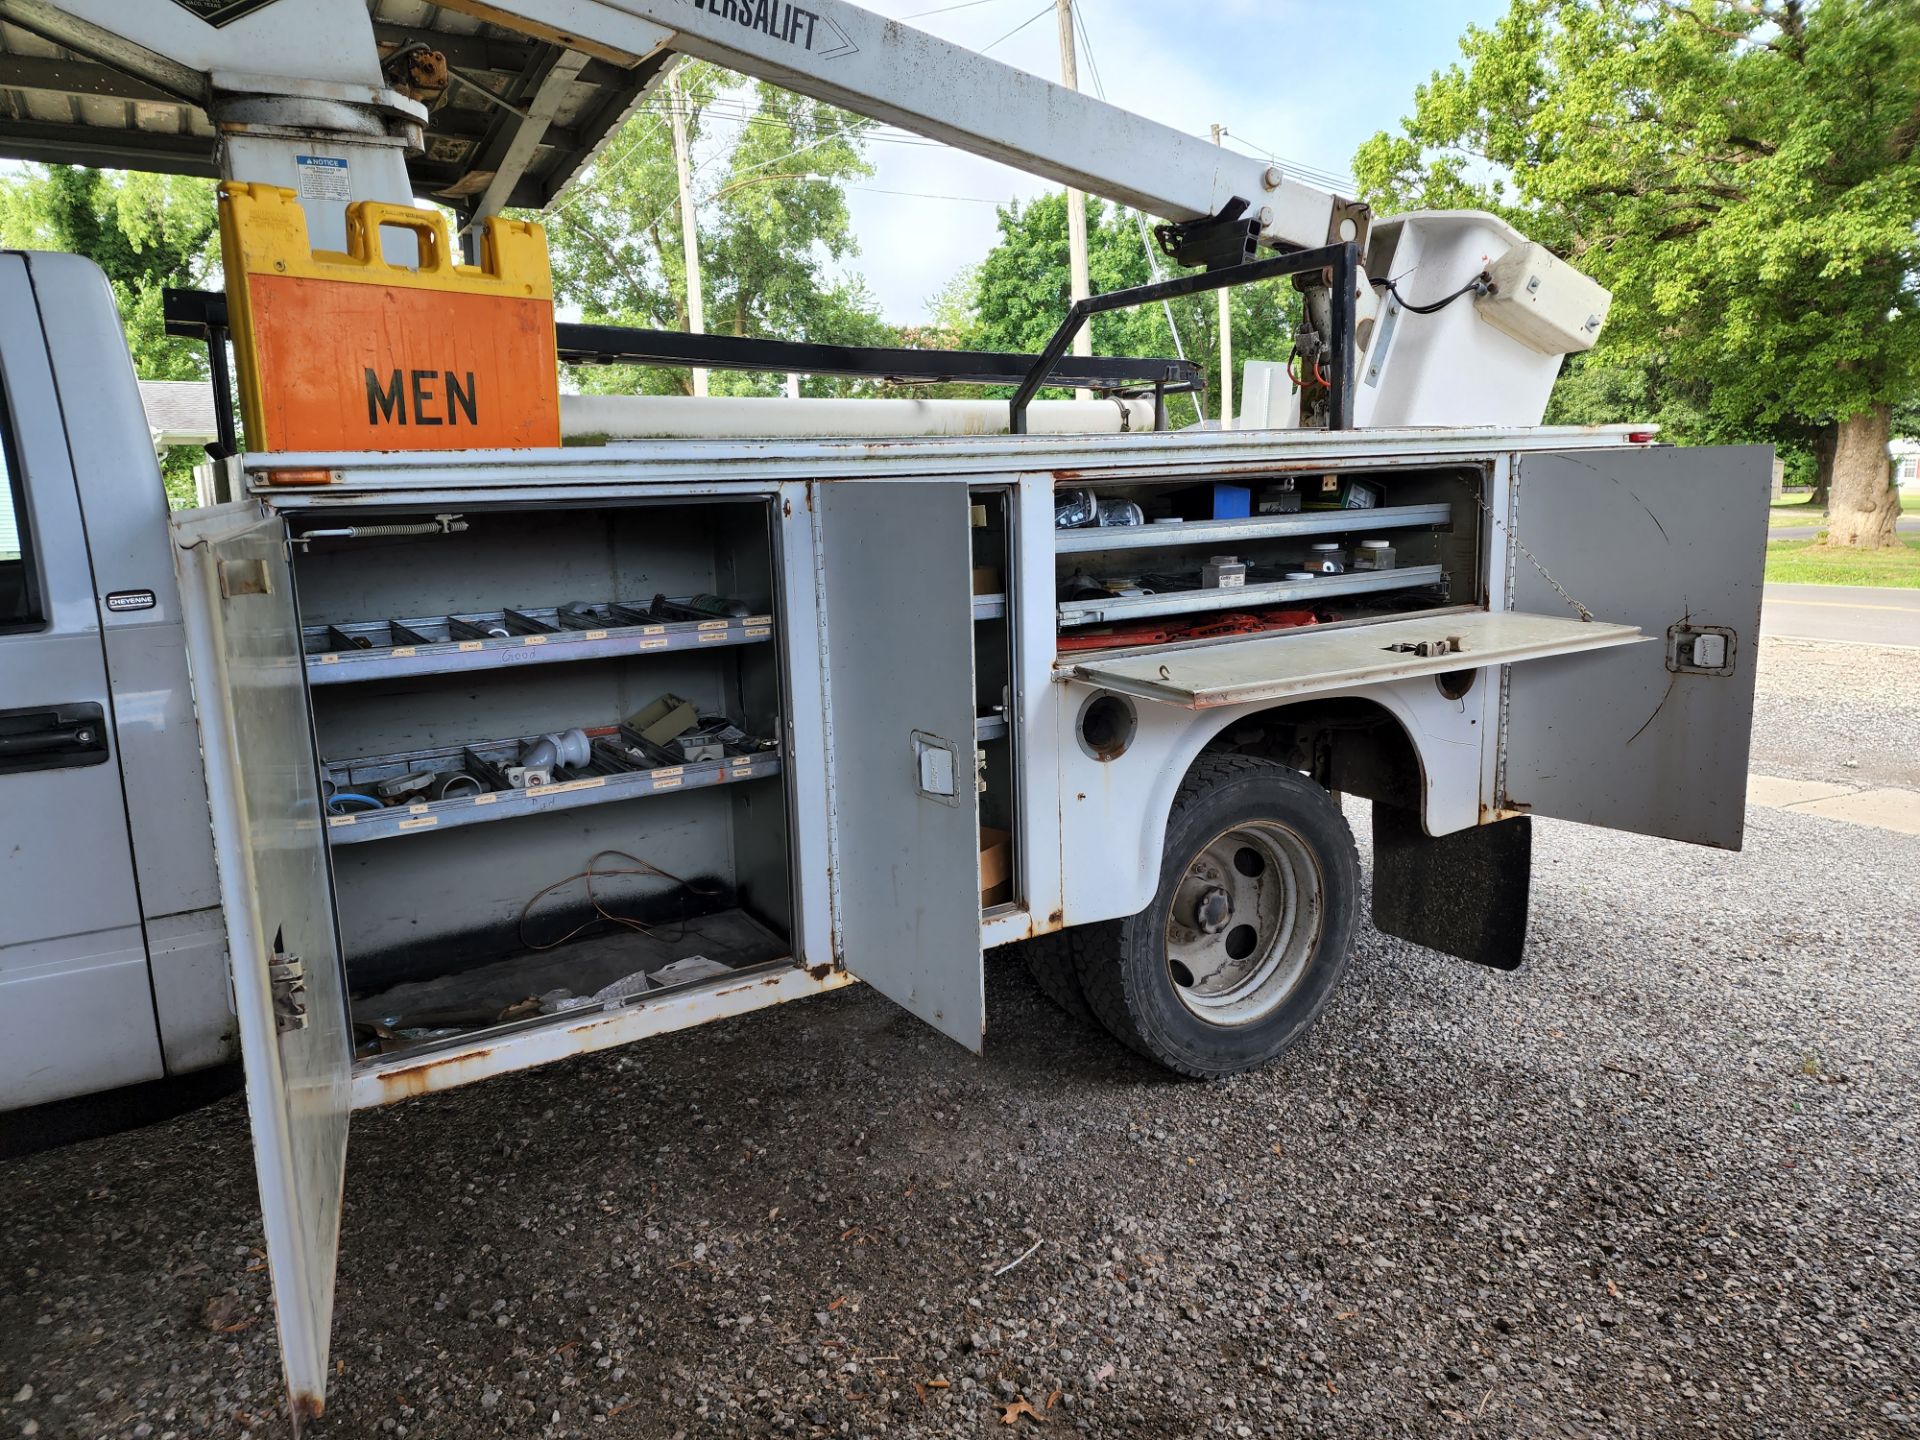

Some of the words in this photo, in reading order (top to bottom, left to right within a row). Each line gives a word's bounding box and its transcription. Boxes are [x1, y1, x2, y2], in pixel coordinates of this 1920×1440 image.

[694, 0, 820, 50] RSALIFT
[312, 158, 339, 167] NOTICE
[364, 367, 478, 425] MEN
[109, 596, 153, 606] CHEYENNE
[501, 647, 537, 662] Good
